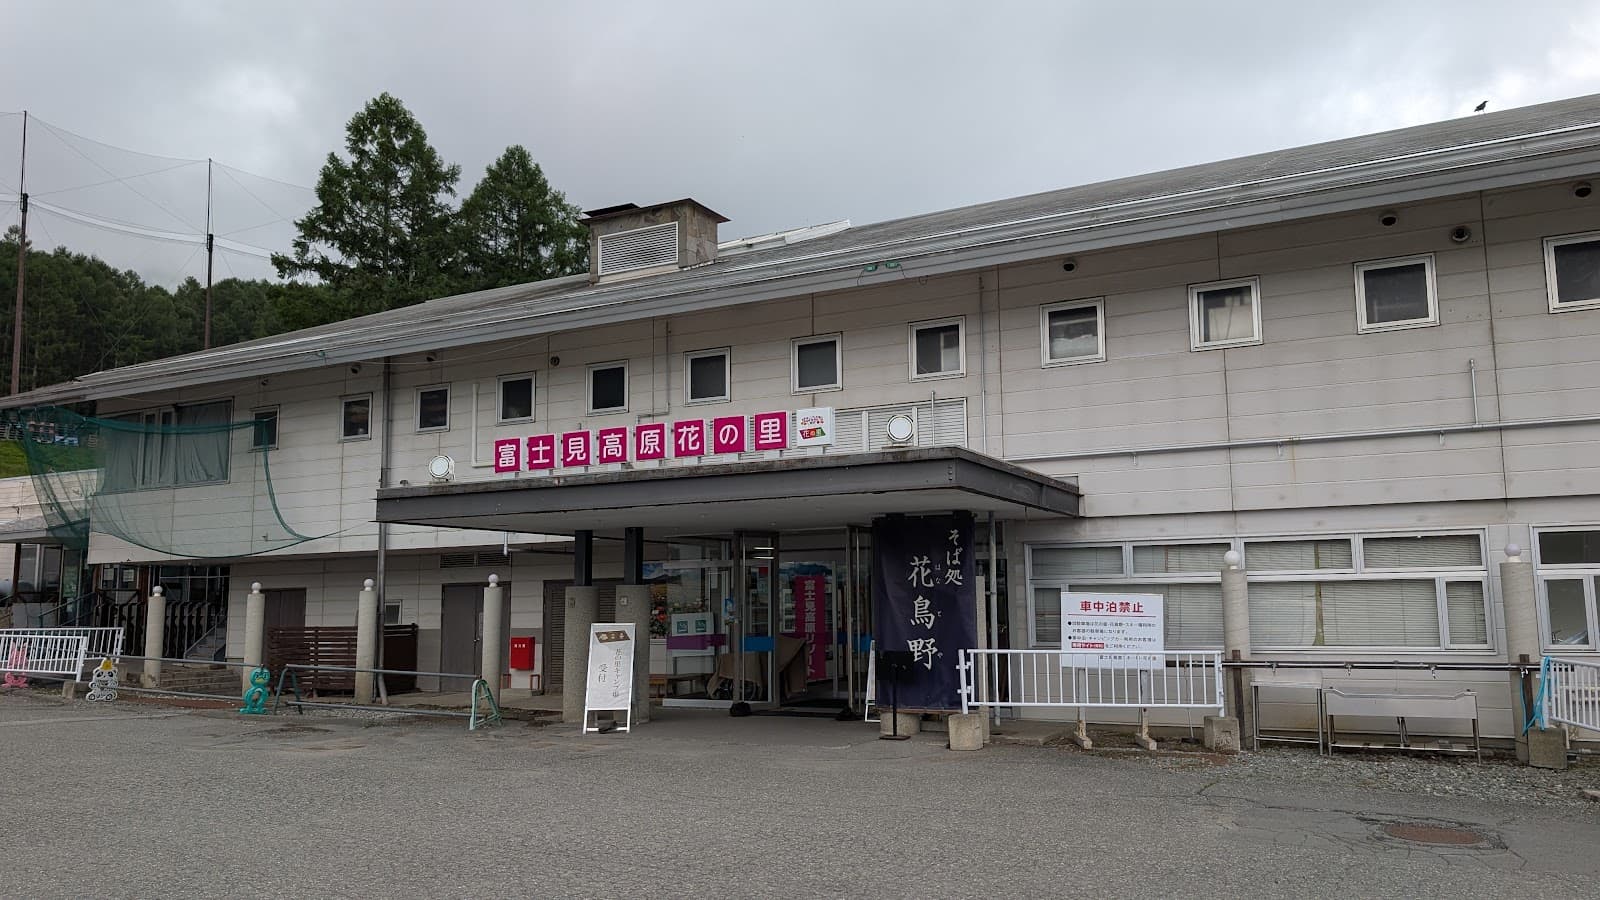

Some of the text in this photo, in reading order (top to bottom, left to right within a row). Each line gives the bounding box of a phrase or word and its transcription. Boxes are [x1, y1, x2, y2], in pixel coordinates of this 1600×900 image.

[498, 418, 783, 467] 富士見高原花の里
[944, 529, 963, 586] そば処
[804, 580, 816, 677] 富士見高原リゾート
[907, 556, 938, 670] 花鳥野
[1080, 600, 1144, 613] 車中泊禁止
[598, 663, 608, 683] 受付
